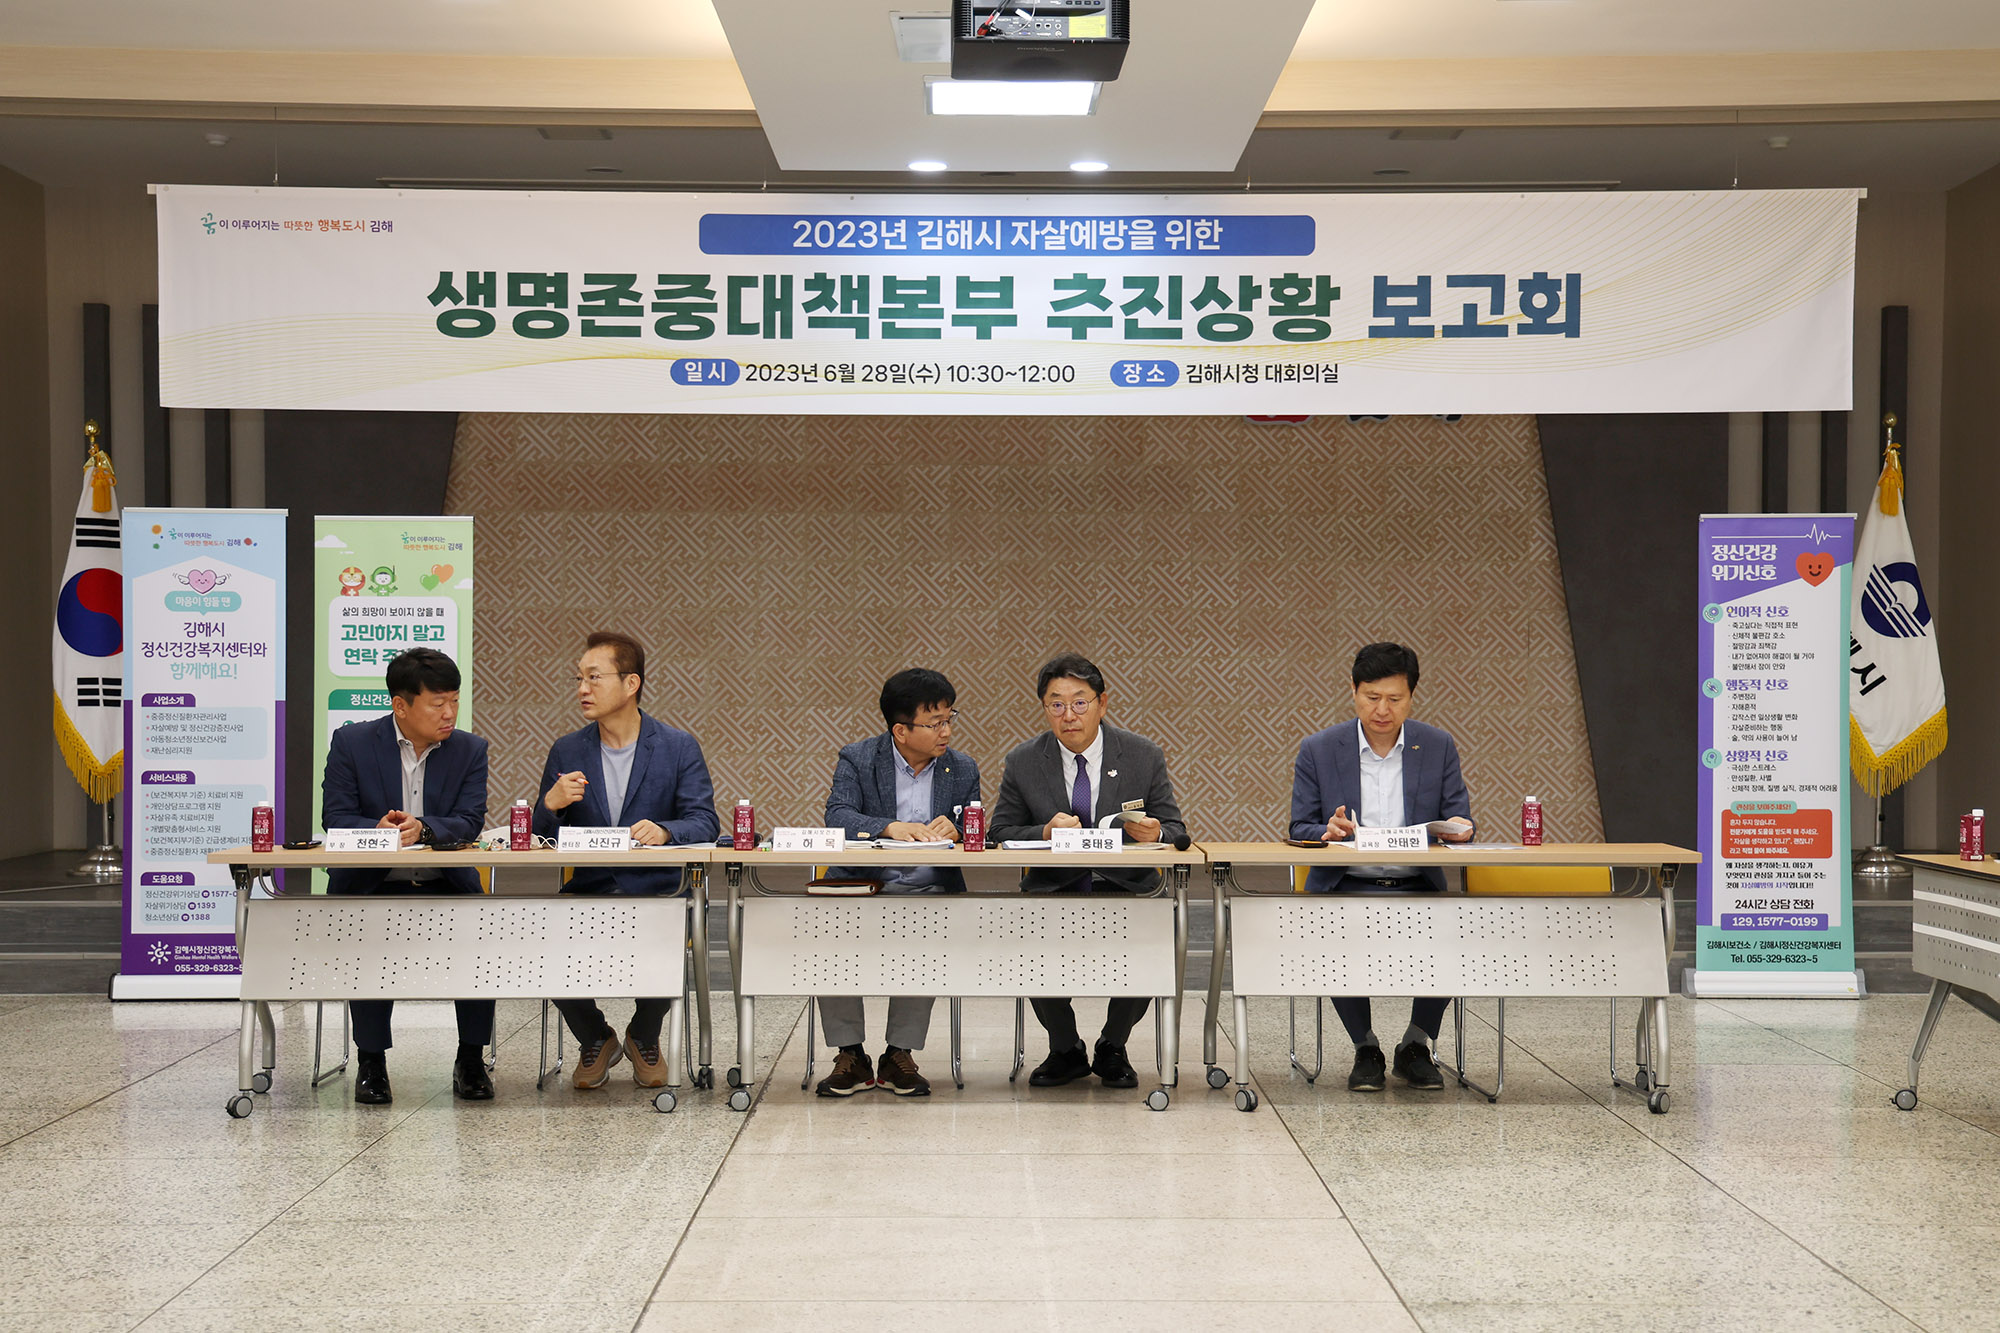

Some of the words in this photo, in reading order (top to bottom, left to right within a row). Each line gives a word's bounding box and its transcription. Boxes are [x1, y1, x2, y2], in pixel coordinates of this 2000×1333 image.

[231, 219, 280, 231] 이루어지는
[284, 219, 314, 232] 따뜻한
[318, 218, 366, 232] 행복도시
[370, 219, 394, 233] 김해
[792, 219, 907, 250] 2023년
[916, 219, 1002, 251] 김해시
[1011, 219, 1157, 251] 자살예방을
[1165, 218, 1223, 251] 위한
[427, 271, 1018, 340] 생명존중대책본부
[1047, 272, 1341, 342] 추진상황
[1368, 272, 1581, 339] 보고회
[745, 363, 818, 384] 2023년
[824, 363, 855, 384] 6월
[861, 363, 942, 385] 28일(수)
[947, 364, 1076, 384] 10:30~12:00
[1186, 364, 1260, 384] 김해시청
[1265, 364, 1339, 384] 대회의실
[448, 542, 463, 551] 김해
[1712, 544, 1778, 561] 정신건강
[1711, 564, 1777, 581] 위기신호
[176, 596, 200, 607] 마음이
[203, 596, 219, 607] 힘들
[222, 596, 231, 607] 땐
[342, 607, 359, 617] 삶의
[362, 607, 387, 617] 희망이
[389, 607, 414, 617] 보이지
[417, 607, 433, 617] 않을
[436, 607, 444, 617] 때
[1726, 606, 1761, 618] 언어적
[1765, 606, 1789, 618] 신호
[184, 622, 225, 638] 김해시
[341, 624, 408, 641] 고민하지
[413, 624, 445, 641] 말고
[141, 642, 267, 658] 정신건강복지센터와
[344, 648, 378, 665] 연락
[170, 662, 237, 680] 함께해요!
[1726, 679, 1761, 691] 행동적
[1765, 679, 1789, 691] 신호
[152, 696, 184, 705] 사업소개
[151, 713, 227, 721] 중증정신질환자관리사업
[151, 724, 178, 732] 자살예방
[181, 724, 187, 732] 및
[189, 724, 244, 732] 정신건강증진사업
[1742, 734, 1754, 742] 약의
[1756, 734, 1774, 742] 사용이
[1776, 734, 1789, 742] 늘어
[151, 747, 193, 755] 재난심리지원
[1725, 750, 1761, 762] 상황적
[1765, 750, 1789, 762] 신호
[1732, 764, 1750, 772] 극심한
[1752, 764, 1776, 772] 스트레스
[149, 774, 188, 782] 서비스내용
[150, 791, 188, 799] (보건복지부
[190, 791, 206, 799] 기준)
[208, 791, 228, 799] 치료비
[230, 791, 244, 799] 지원
[150, 814, 177, 822] 자살유족
[150, 825, 206, 833] 개별맞춤형서비스
[207, 825, 221, 833] 지원
[206, 836, 239, 844] 긴급생계비
[356, 838, 390, 849] 천현수
[588, 838, 622, 848] 신진규
[1082, 839, 1114, 849] 홍태용
[1388, 838, 1420, 848] 안태환
[152, 875, 183, 884] 도움요청
[145, 902, 186, 910] 자살위기상담
[1735, 899, 1768, 910] 24시간
[1770, 899, 1790, 910] 상담
[1793, 899, 1814, 910] 전화
[1732, 917, 1755, 927] 129,
[1758, 917, 1818, 927] 1577-0199
[1706, 941, 1751, 950] 김해시보건소
[1760, 941, 1842, 950] 김해시정신건강복지센터
[1731, 954, 1745, 963] Tel.
[1746, 954, 1818, 963] 055-329-6323~5
